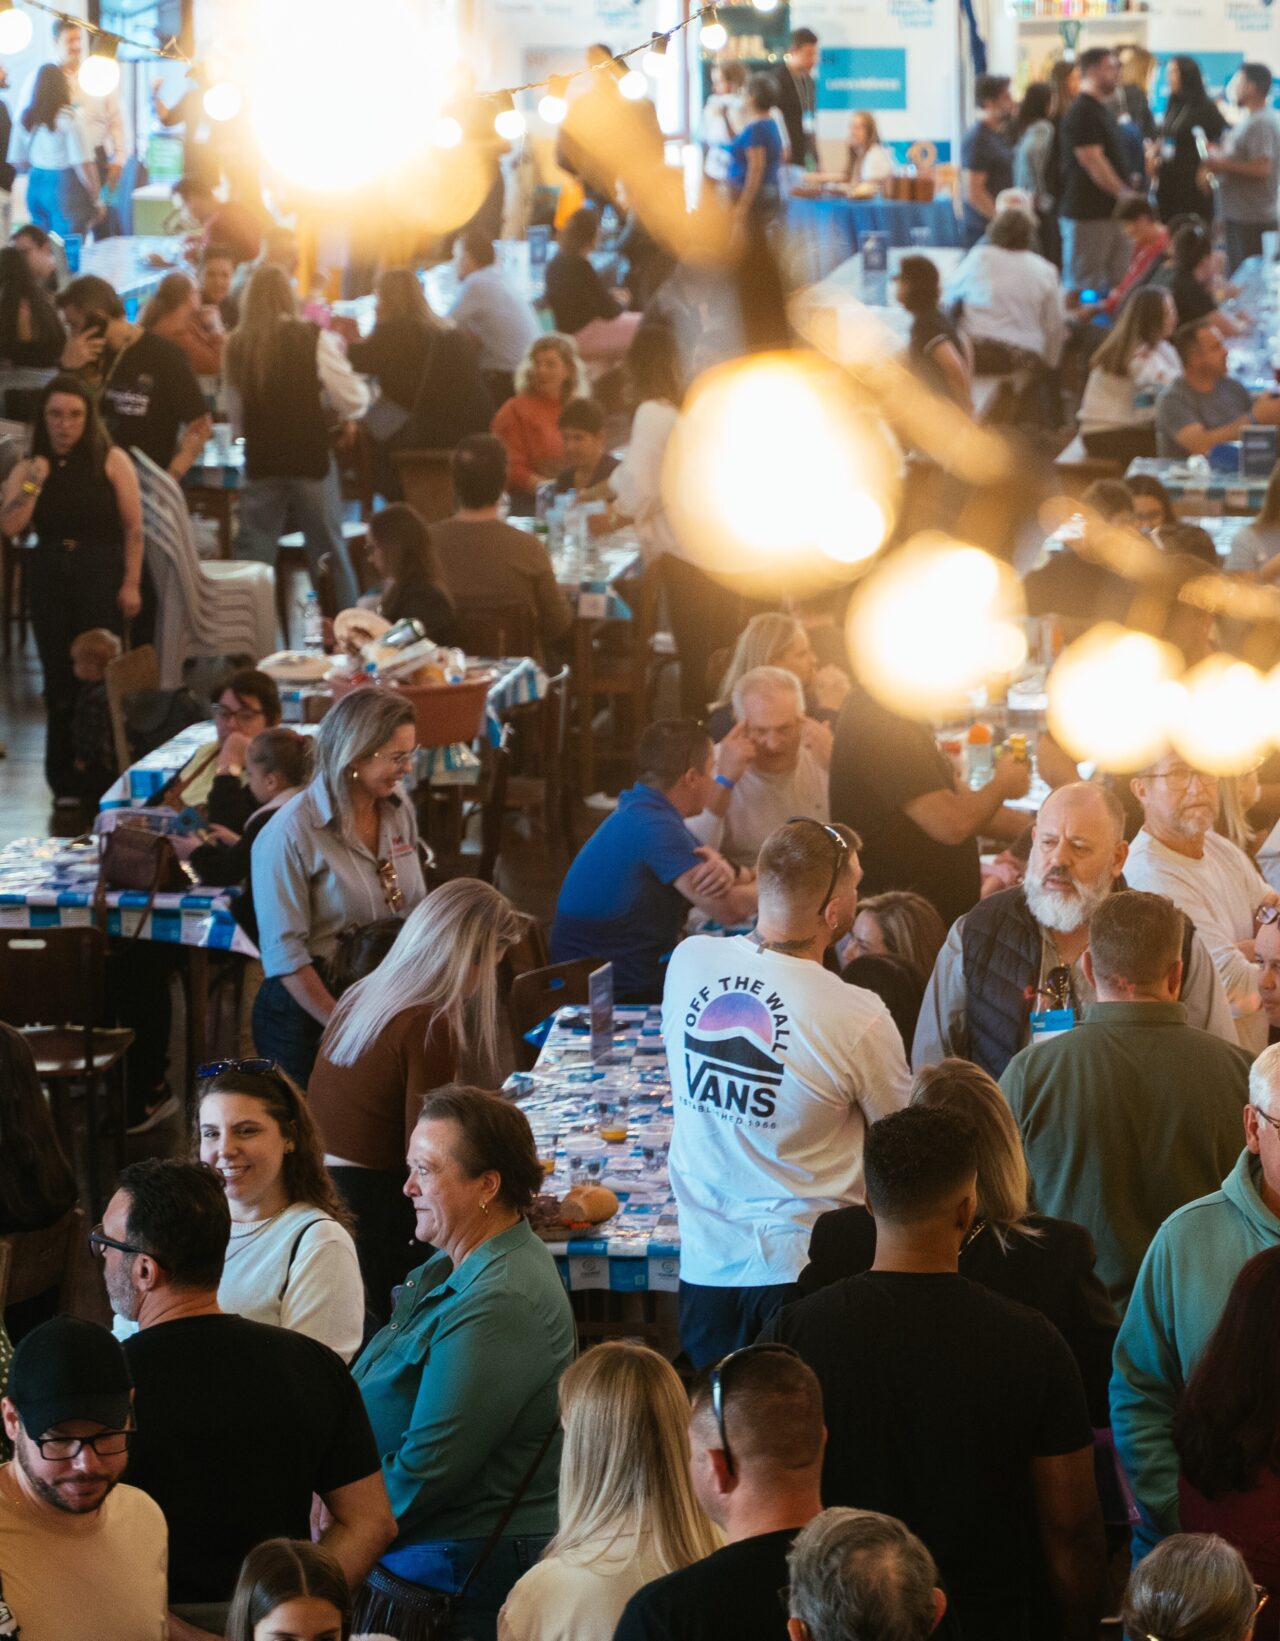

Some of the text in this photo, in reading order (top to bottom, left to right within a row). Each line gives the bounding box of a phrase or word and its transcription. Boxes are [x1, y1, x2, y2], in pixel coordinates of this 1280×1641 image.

[685, 976, 791, 1053] OFF THE WALL
[685, 1053, 782, 1118] VANS
